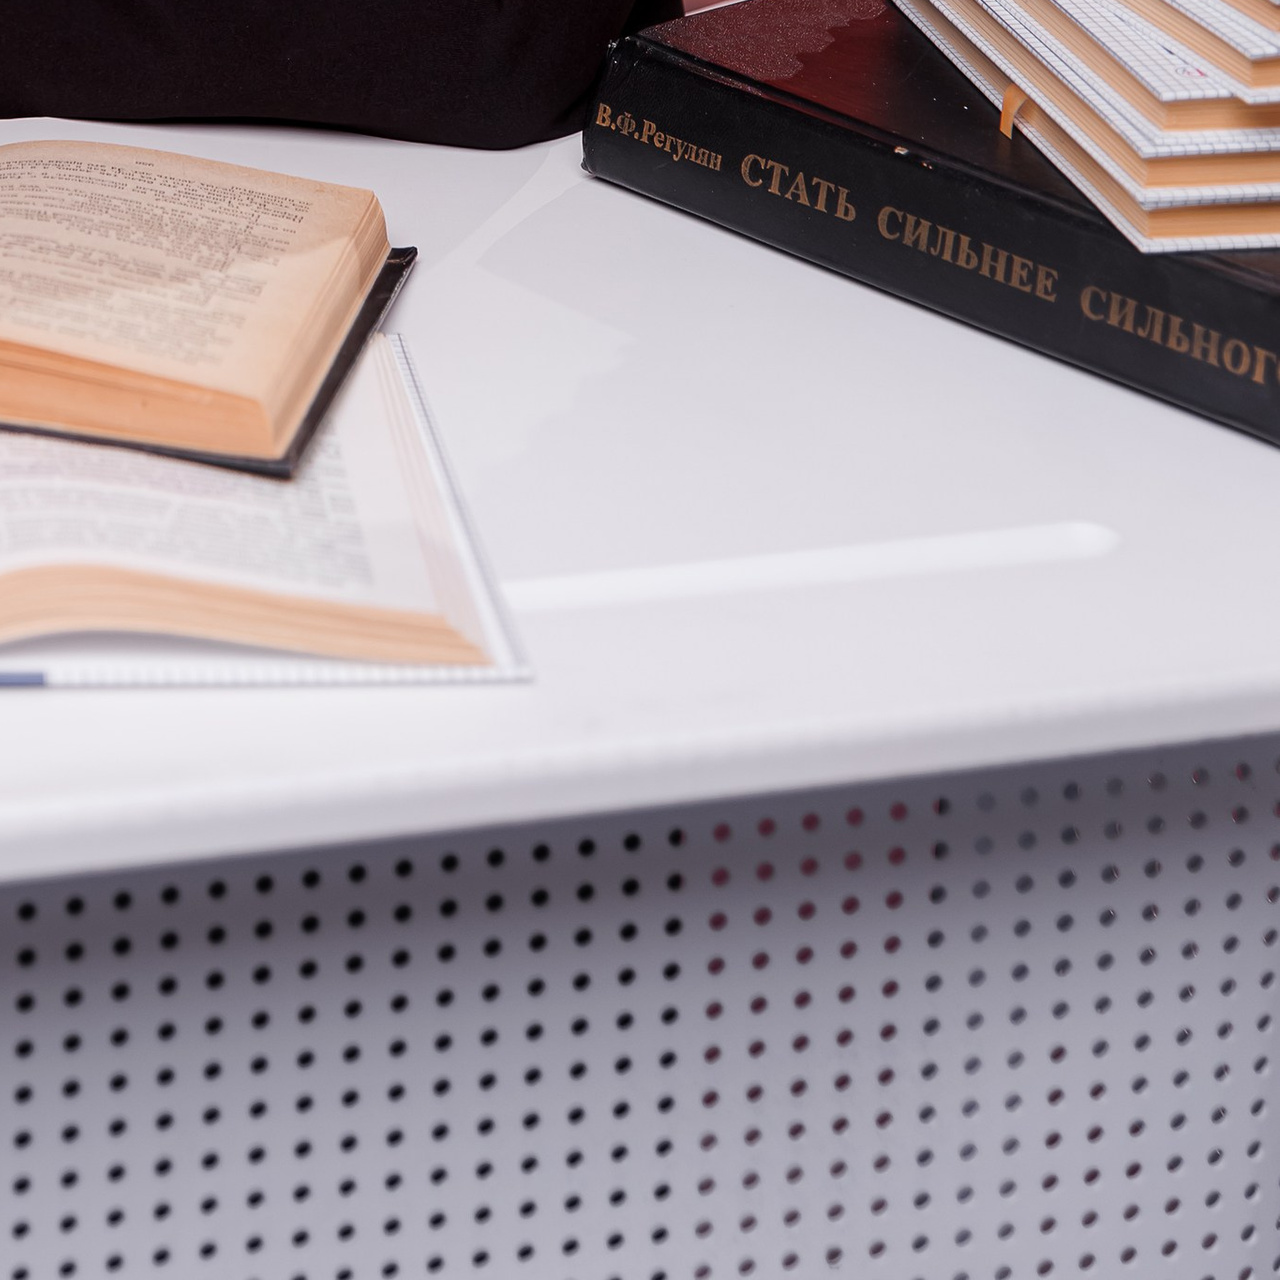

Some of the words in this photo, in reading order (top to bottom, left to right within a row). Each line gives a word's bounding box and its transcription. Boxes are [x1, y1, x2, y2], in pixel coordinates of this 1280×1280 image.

[741, 154, 856, 222] СТАТЬ
[877, 206, 1059, 303] СИЛЬНЕЕ
[1080, 286, 1280, 385] СИЛЬНОГ
